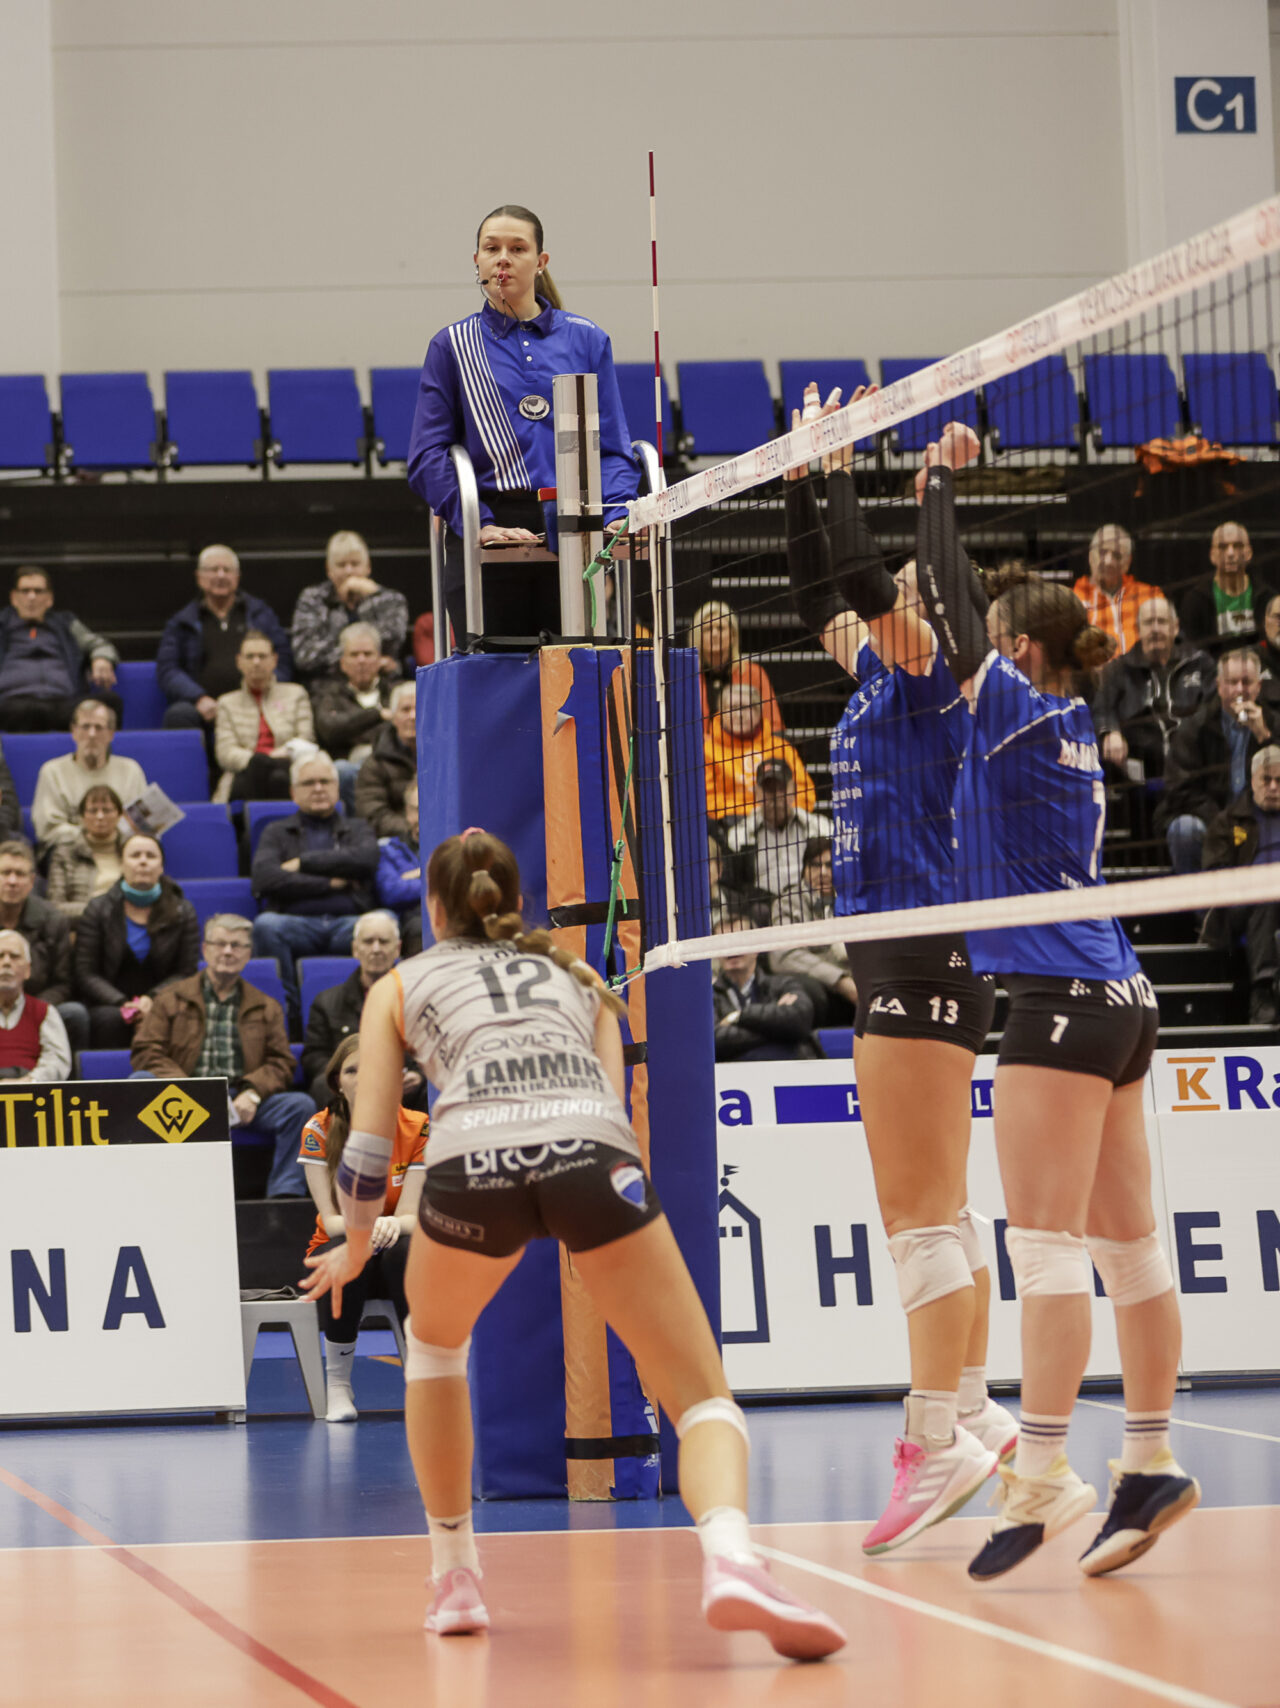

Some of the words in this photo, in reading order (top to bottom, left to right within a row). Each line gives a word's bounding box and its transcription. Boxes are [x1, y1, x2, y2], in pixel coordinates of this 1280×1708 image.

[1187, 79, 1244, 131] C1
[475, 958, 560, 1014] 12
[928, 995, 959, 1025] 13
[1049, 1014, 1069, 1044] 7
[466, 1053, 603, 1089] LAMMIN
